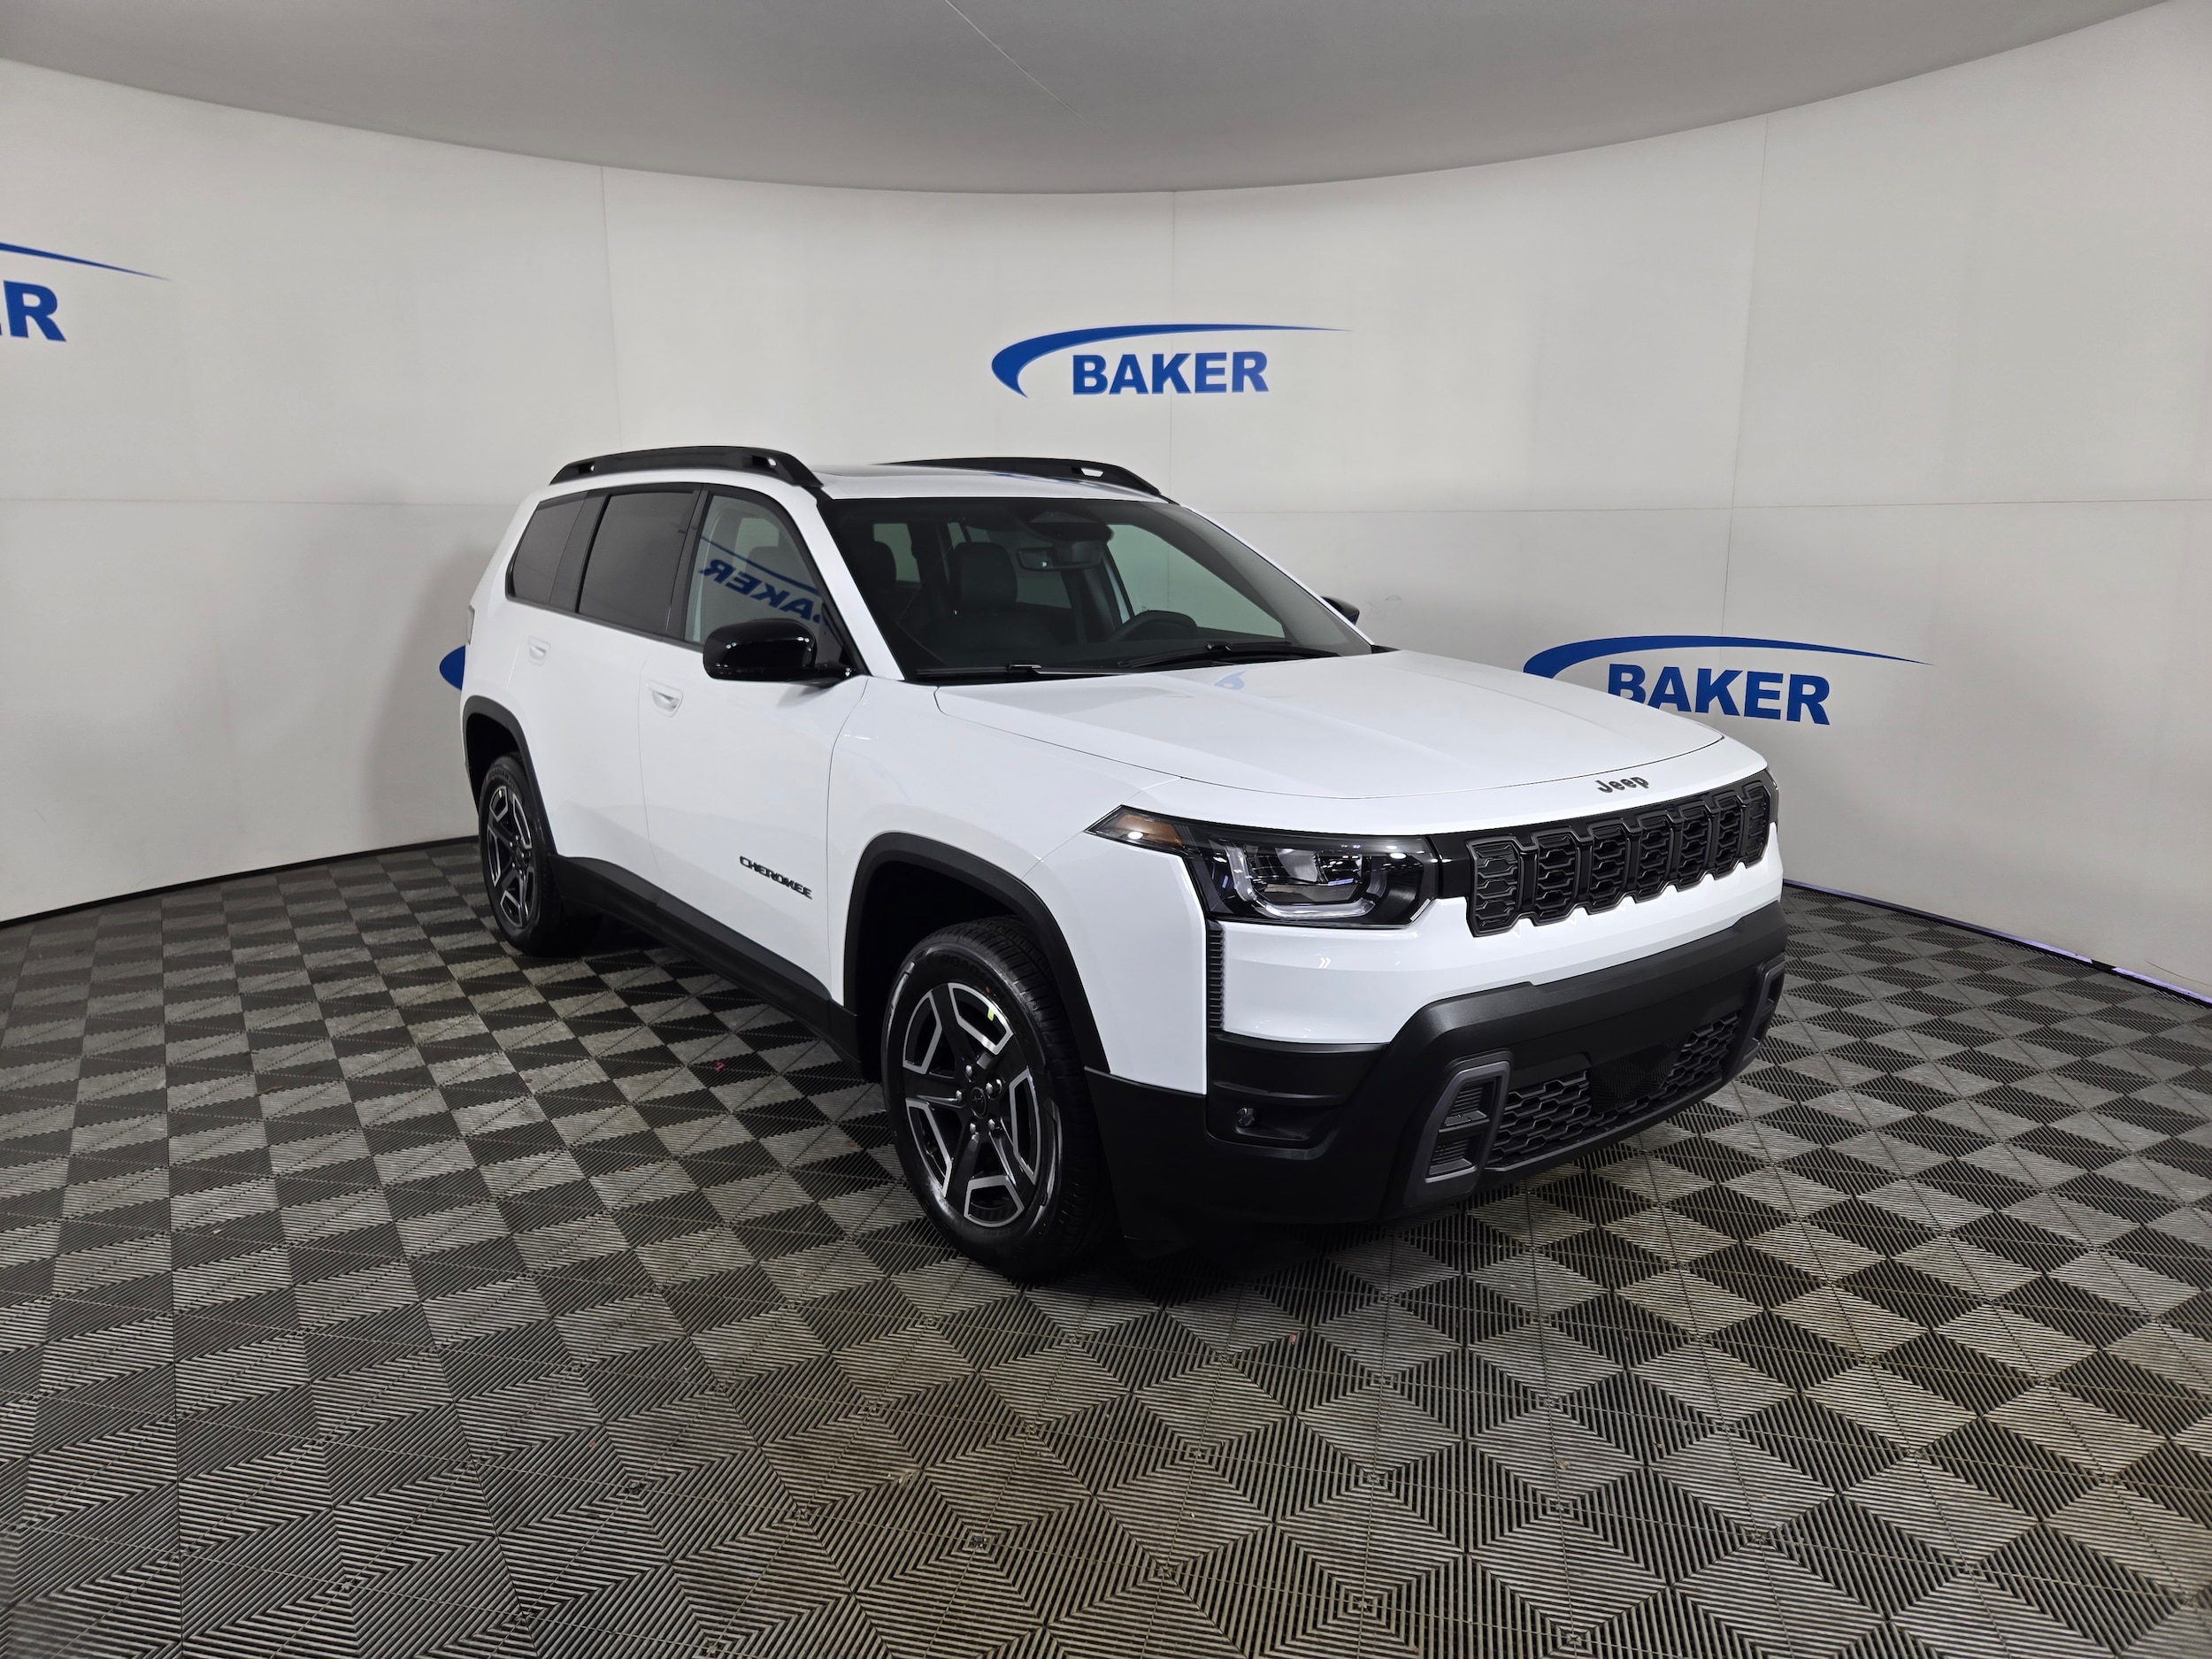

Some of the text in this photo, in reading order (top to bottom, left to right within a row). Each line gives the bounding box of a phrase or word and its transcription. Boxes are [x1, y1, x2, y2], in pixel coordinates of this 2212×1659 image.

[1072, 351, 1269, 395] BAKER
[1608, 664, 1830, 725] BAKER
[1594, 777, 1649, 793] Jeep
[740, 856, 812, 900] CHEROKEE
